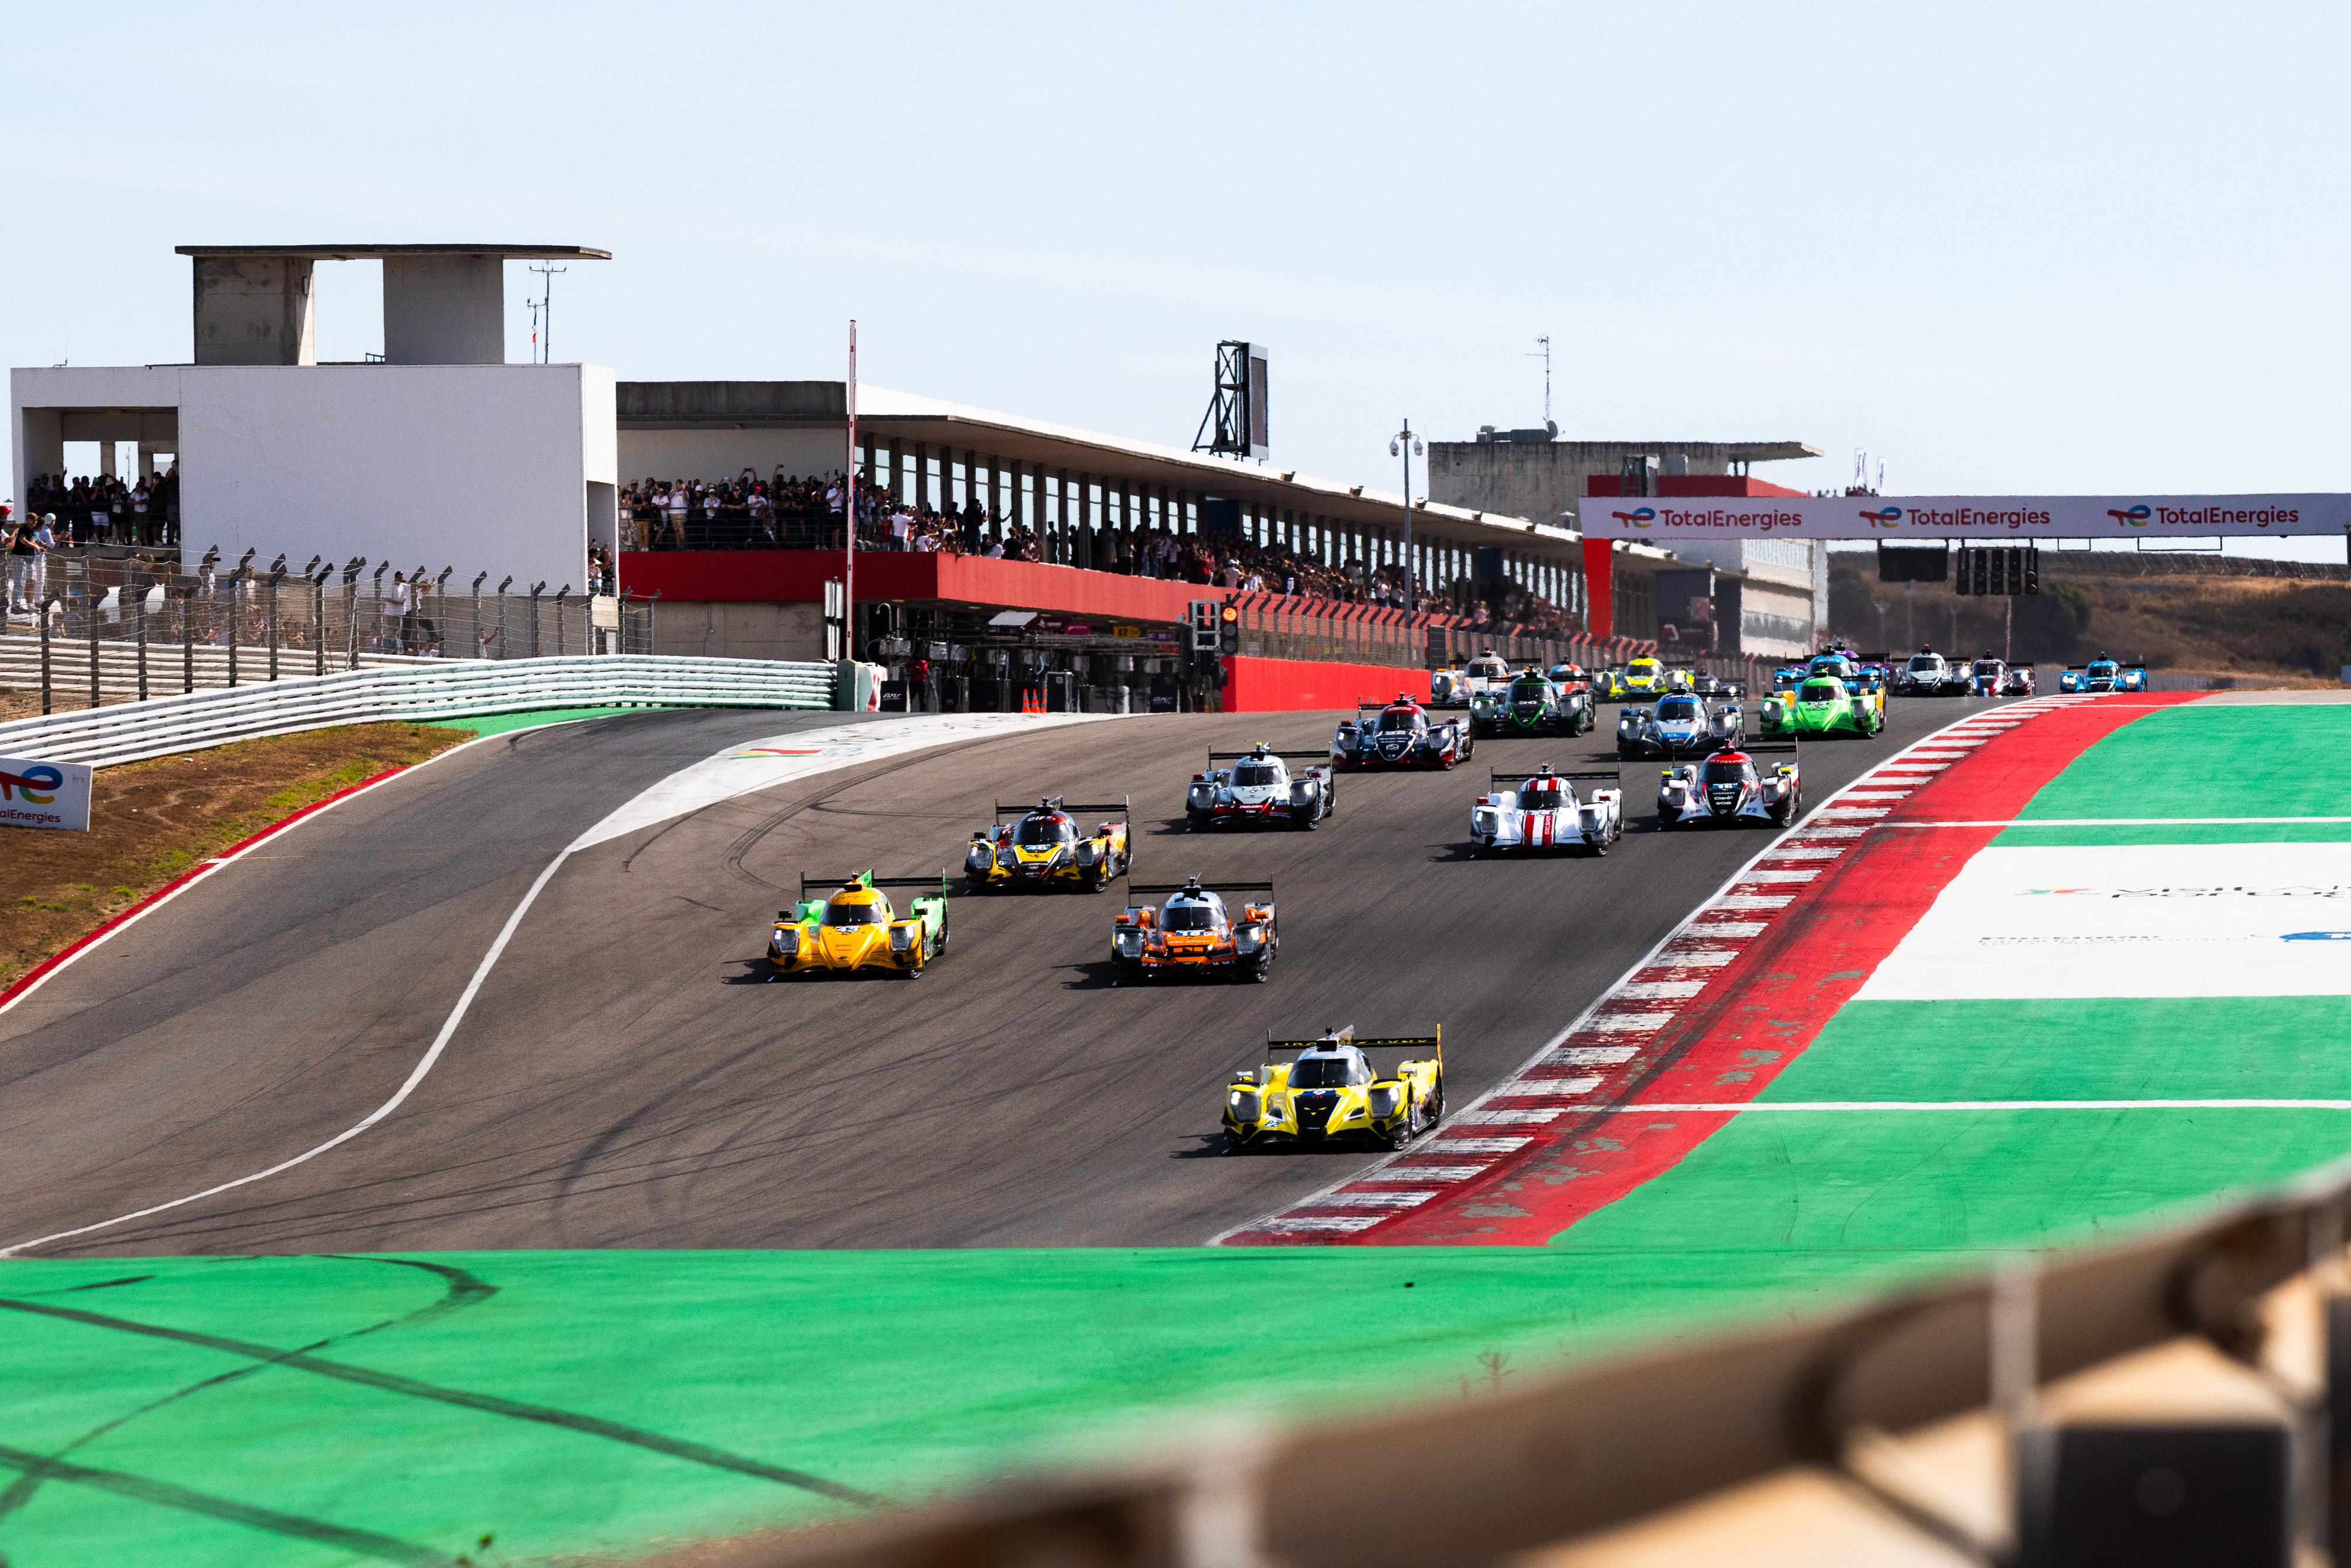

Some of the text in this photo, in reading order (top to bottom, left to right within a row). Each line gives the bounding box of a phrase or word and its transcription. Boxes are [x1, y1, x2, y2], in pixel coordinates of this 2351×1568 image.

[1660, 509, 1801, 530] TotalEnergies
[1907, 508, 2050, 528] TotalEnergies
[2156, 505, 2299, 526] TotalEnergies
